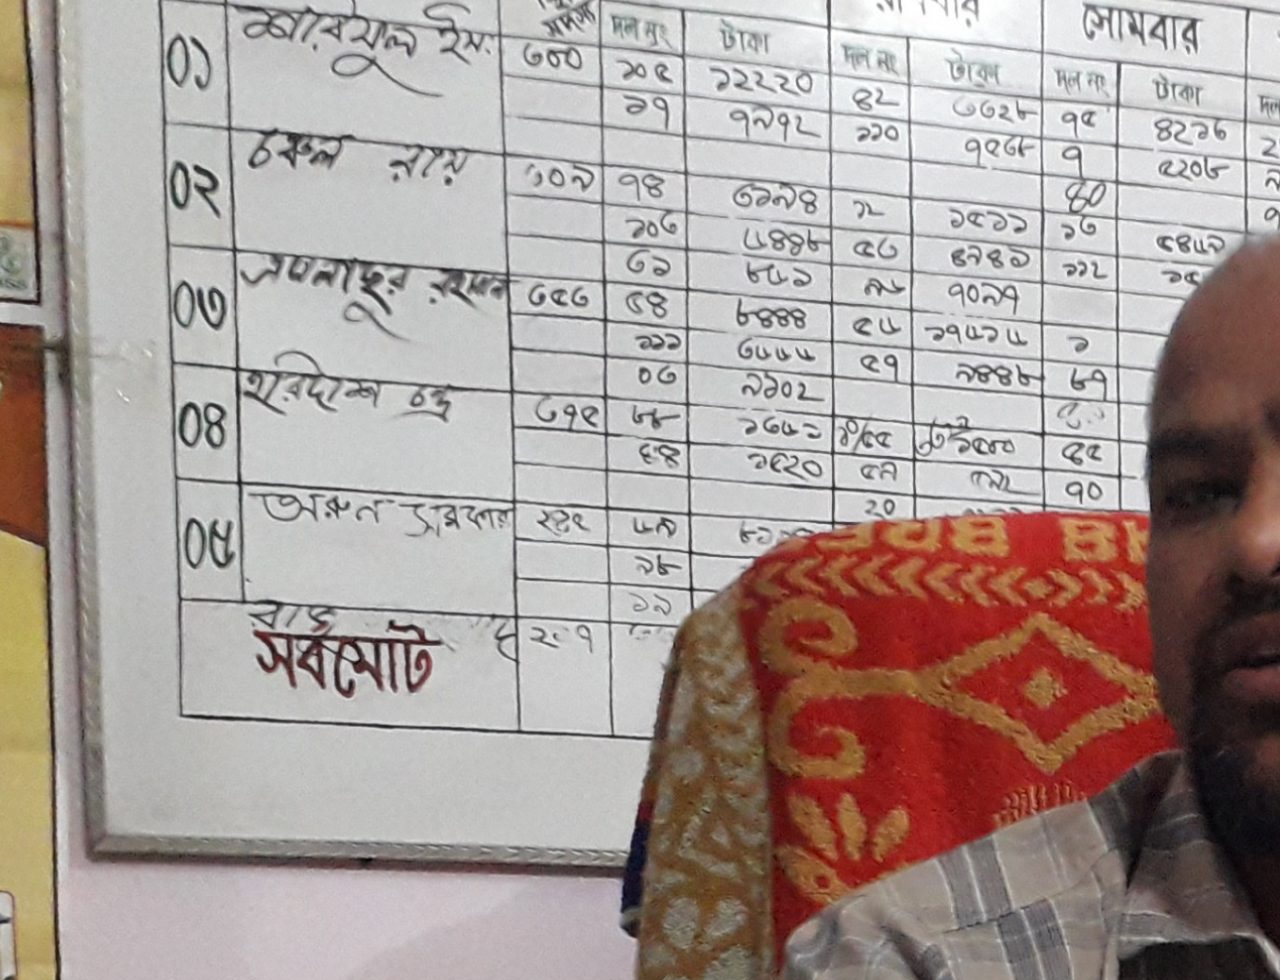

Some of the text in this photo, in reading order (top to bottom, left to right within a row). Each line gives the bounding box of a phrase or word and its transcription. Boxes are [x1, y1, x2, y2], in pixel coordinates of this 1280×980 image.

[718, 18, 771, 54] টাকা
[1082, 4, 1202, 54] সোমবার
[944, 48, 1002, 83] টাকা
[1153, 73, 1204, 106] টাকা
[171, 160, 221, 218] ০২
[173, 280, 227, 331] ০৩
[179, 400, 227, 448] ০৪
[184, 517, 236, 569] ০৫
